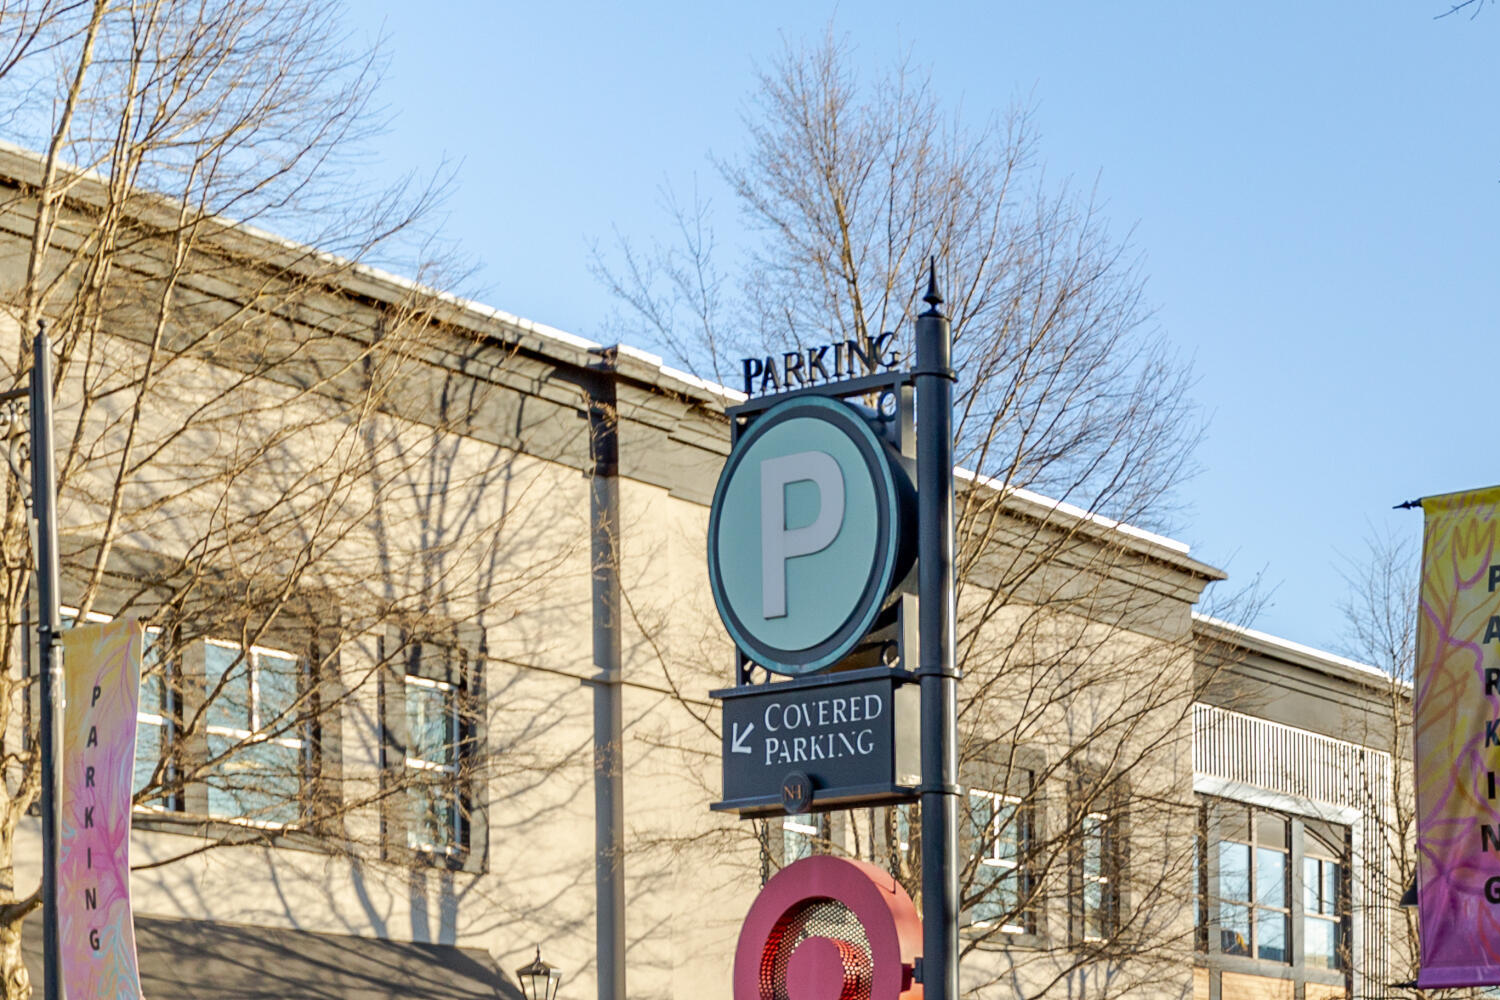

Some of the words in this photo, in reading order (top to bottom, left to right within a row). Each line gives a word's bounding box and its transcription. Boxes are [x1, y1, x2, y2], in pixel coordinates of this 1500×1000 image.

[741, 332, 900, 394] PARKING
[760, 451, 847, 620] P
[764, 694, 883, 732] COVERED
[764, 729, 875, 766] PARKING
[85, 685, 102, 951] PARKING
